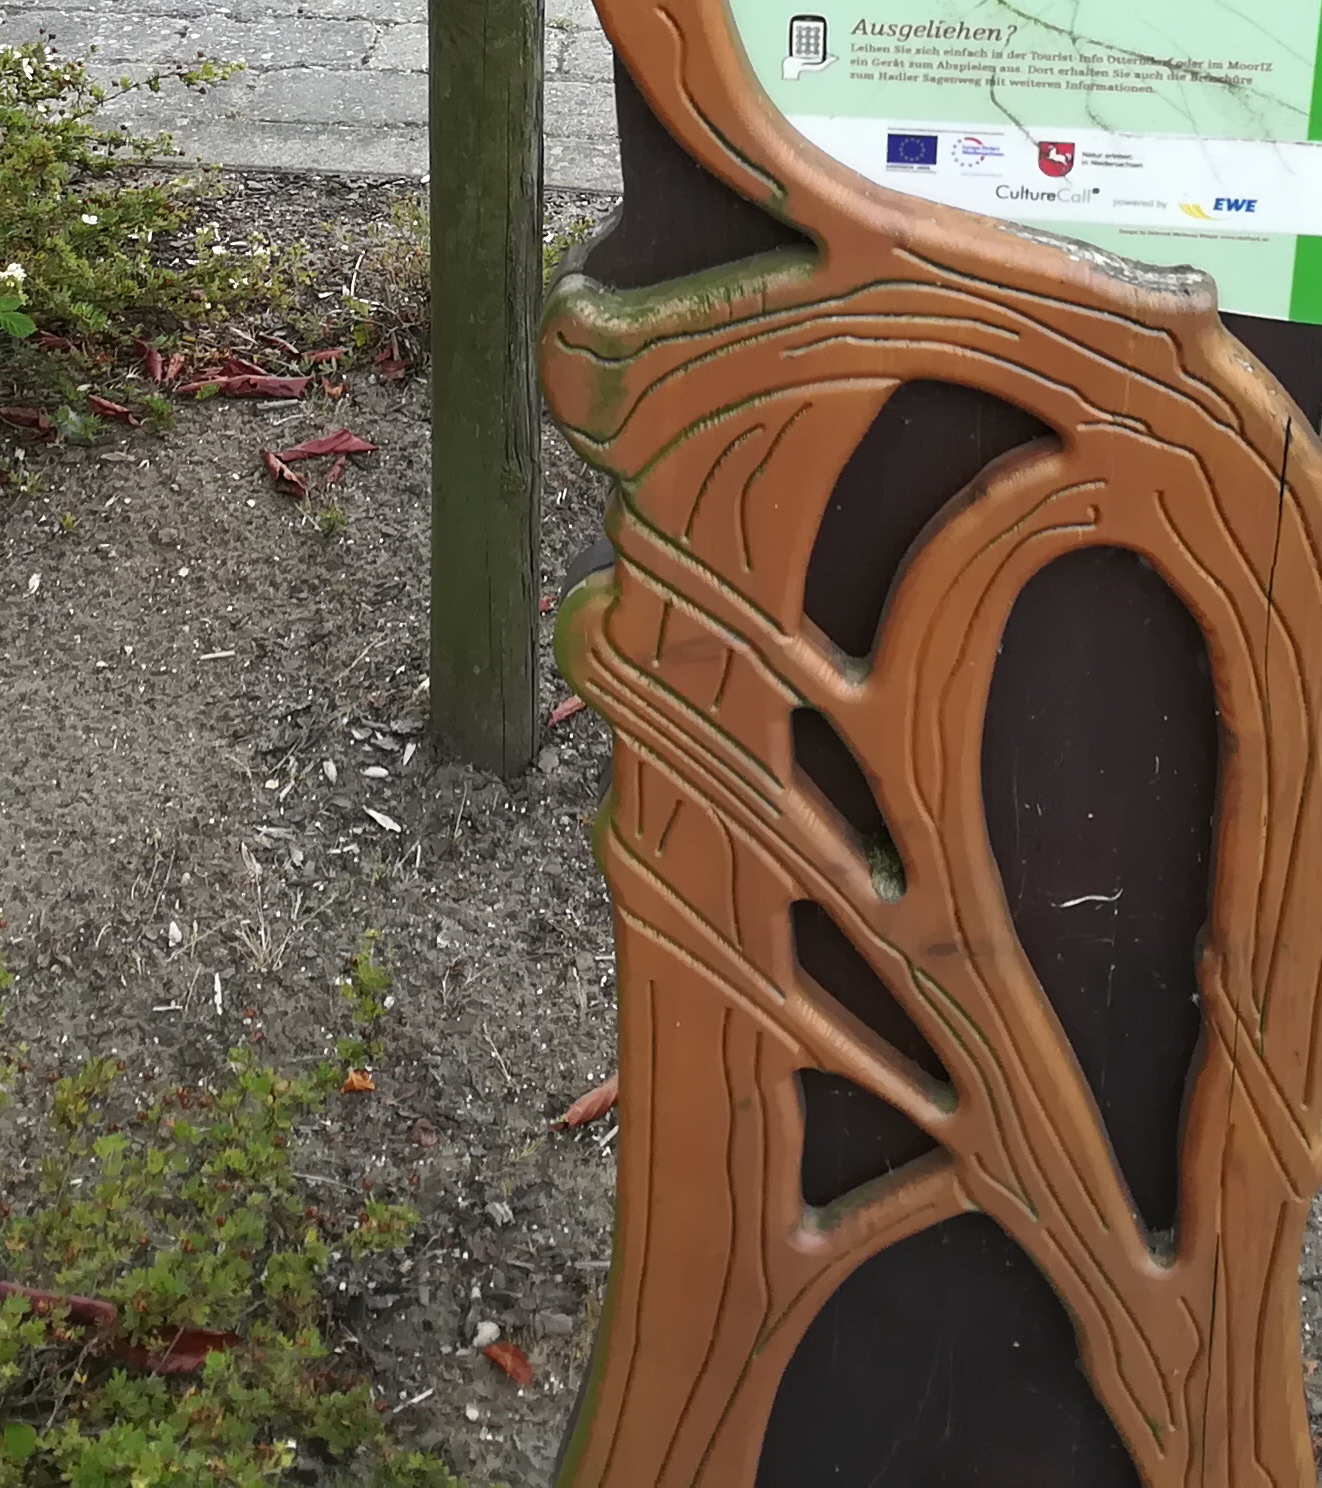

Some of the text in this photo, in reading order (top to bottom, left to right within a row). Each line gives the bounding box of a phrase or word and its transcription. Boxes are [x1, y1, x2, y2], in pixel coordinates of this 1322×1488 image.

[851, 19, 1018, 44] Ausgeliehen?
[851, 44, 890, 54] Leihen
[894, 45, 912, 55] Sie
[915, 46, 940, 56] sich
[943, 48, 988, 58] einfach
[992, 49, 1003, 59] in
[1007, 50, 1027, 60] der
[1208, 59, 1223, 69] im
[850, 57, 869, 66] ein
[872, 58, 904, 68] Gerät
[909, 60, 934, 69] zum
[937, 61, 996, 73] Abspielen
[1028, 65, 1055, 75] Dort
[1058, 66, 1109, 77] erhalten
[1112, 69, 1131, 78] Sie
[1134, 70, 1163, 80] auch
[1167, 71, 1187, 81] die
[850, 72, 874, 81] zum
[878, 71, 918, 82] Hadler
[922, 73, 982, 87] Sagenweg
[985, 76, 1005, 87] mit
[1009, 78, 1062, 89] weiteren
[1113, 197, 1258, 213] powered by EWE
